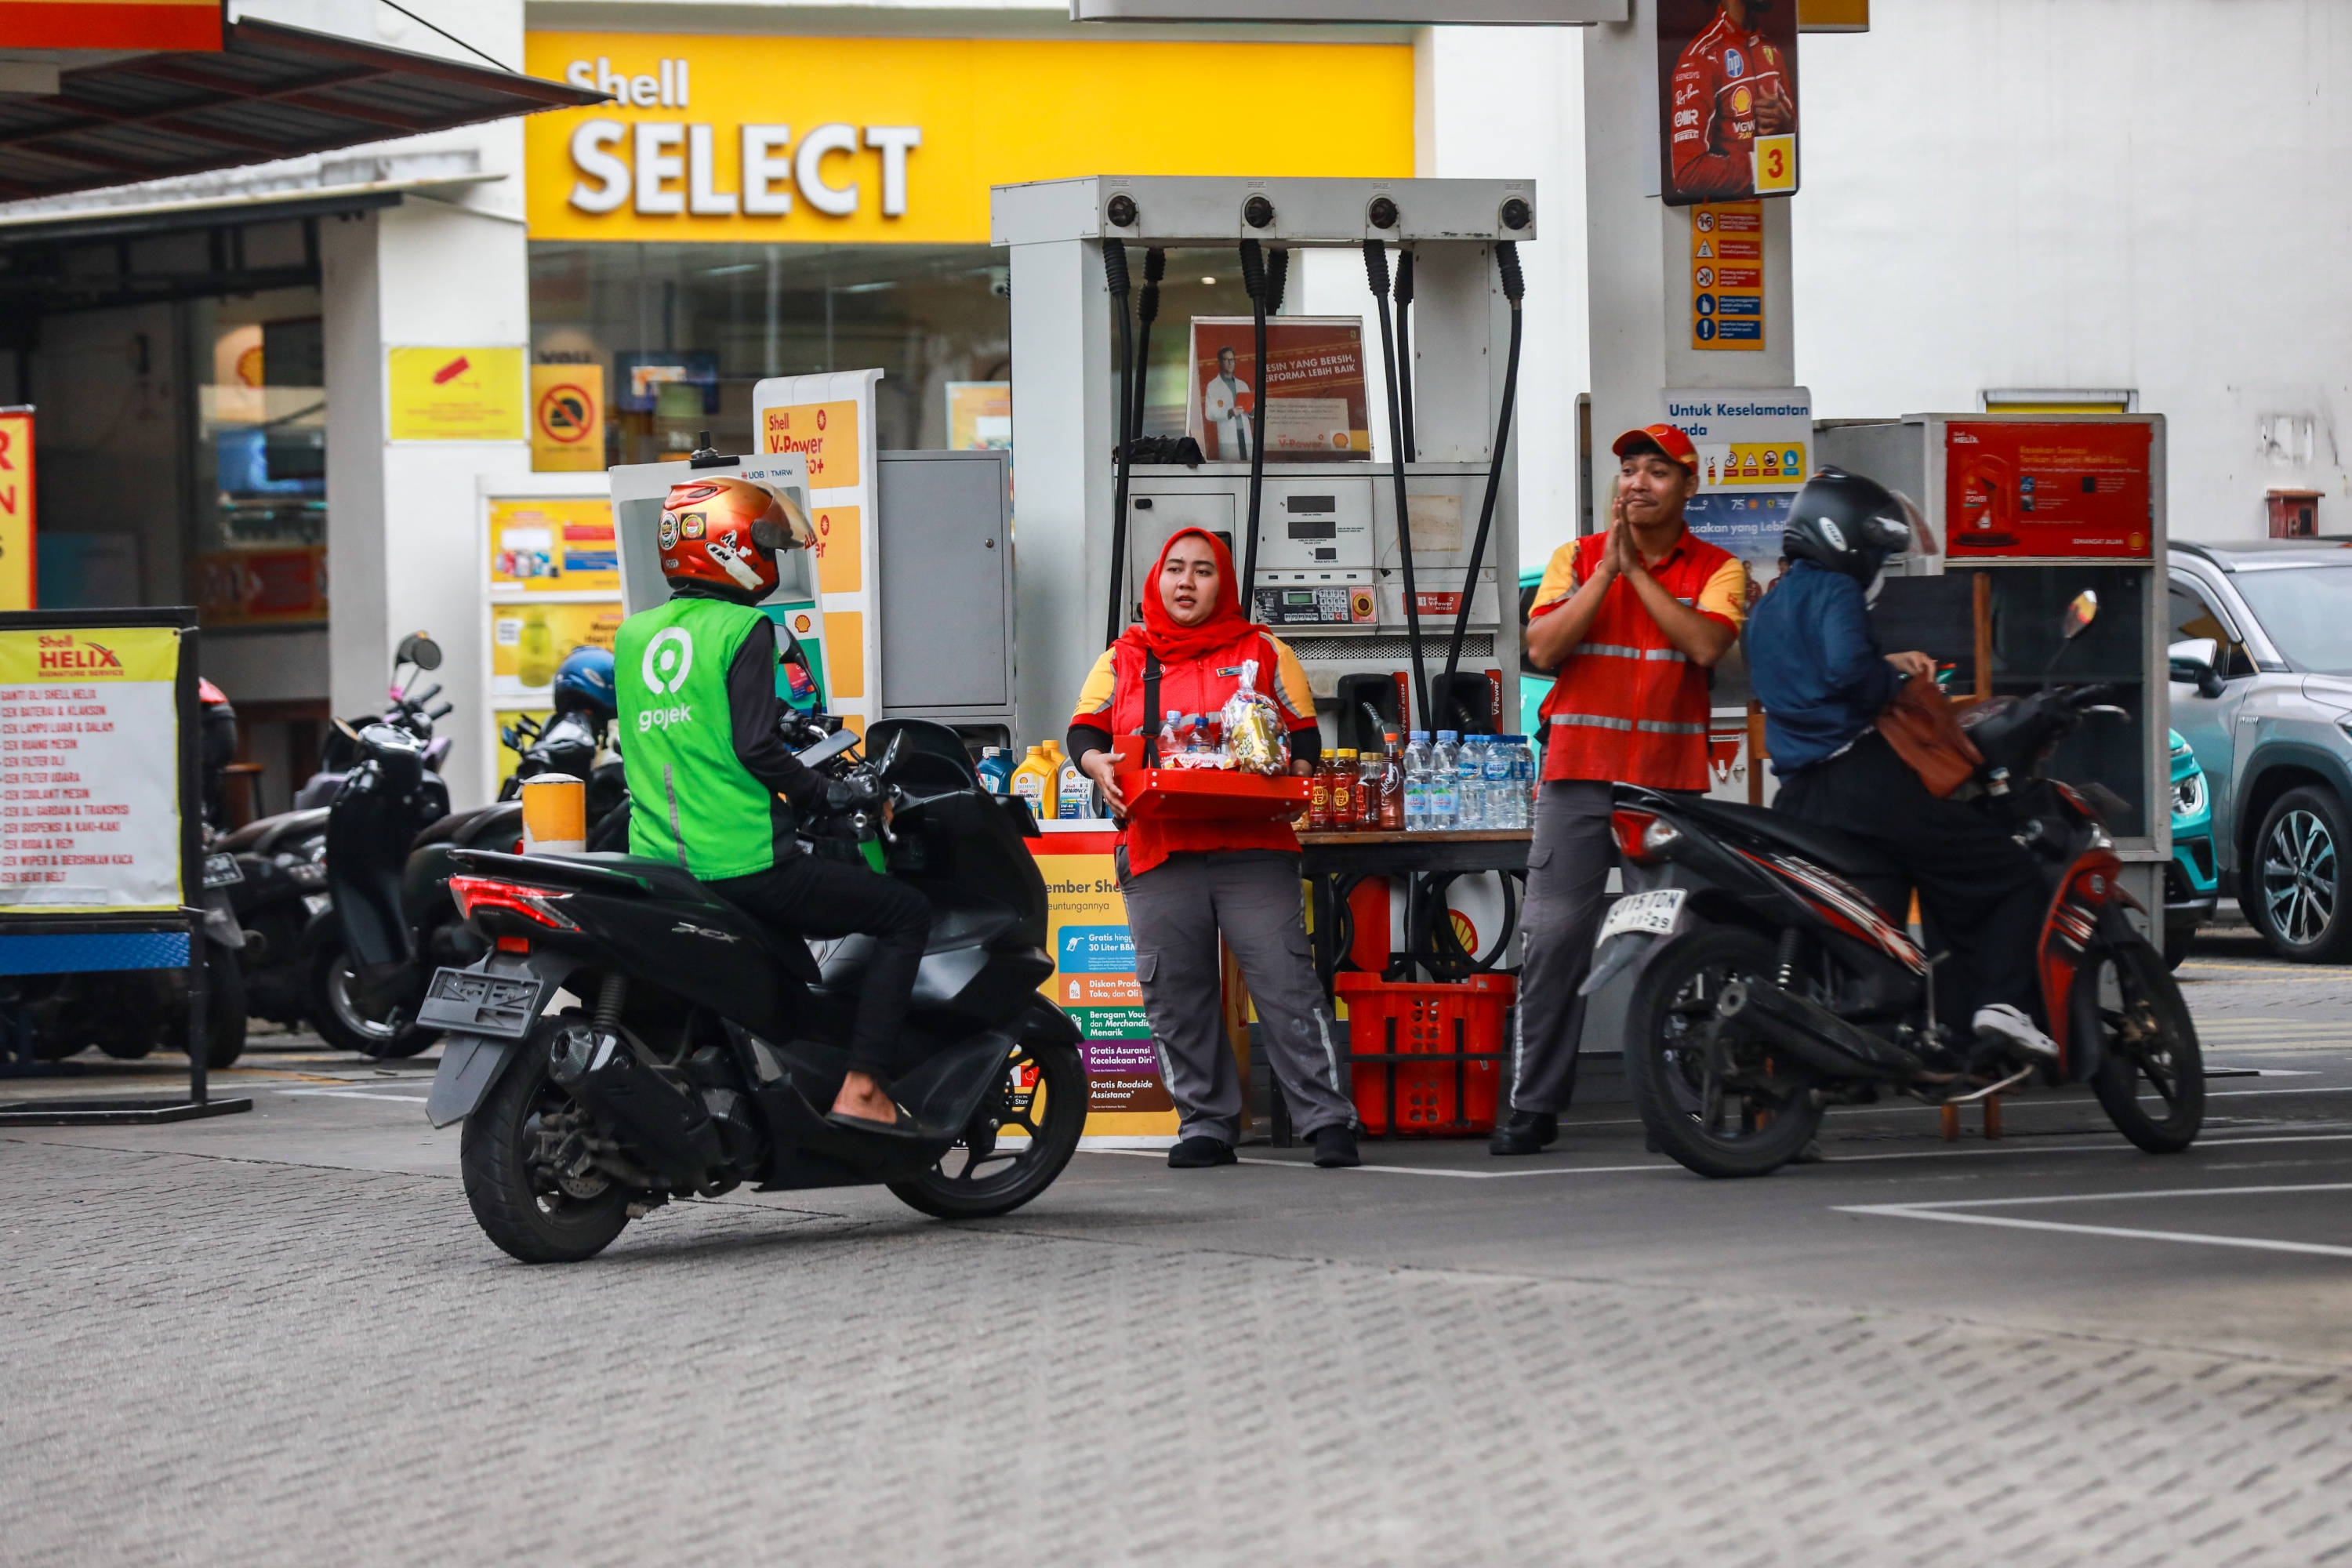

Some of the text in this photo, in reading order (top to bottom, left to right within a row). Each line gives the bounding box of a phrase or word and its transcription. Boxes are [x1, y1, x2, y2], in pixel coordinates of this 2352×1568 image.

[565, 56, 689, 107] Shell
[1733, 119, 1755, 132] VGW
[568, 119, 923, 216] SELECT
[1767, 149, 1784, 179] 3
[1266, 354, 1356, 372] ESIN YANG BERSIH,
[1265, 364, 1356, 383] ERFORMA LEBIH BAIK
[1670, 403, 1809, 416] Untuk Keselamatan
[769, 412, 789, 431] Shell
[770, 434, 823, 455] V-Power
[1279, 439, 1323, 448] V-Power
[1689, 522, 1728, 534] asakan
[1731, 524, 1758, 535] yang
[38, 634, 73, 648] Shell
[40, 649, 121, 669] HELIX
[45, 689, 71, 699] SHELL
[73, 689, 96, 699] HELIX
[67, 705, 107, 716] KLAKSON
[639, 702, 691, 732] gojek
[21, 723, 47, 733] LAMPU
[85, 722, 114, 732] DALAM
[51, 739, 77, 749] MESIN
[22, 756, 48, 766] FILTER
[23, 773, 48, 782] FILTER
[23, 789, 59, 800] COOLANT
[63, 789, 90, 799] MESIN
[56, 838, 74, 848] REM
[21, 855, 48, 866] WIPER
[20, 872, 42, 882] SEAT
[45, 871, 66, 882] BELT
[1046, 879, 1120, 893] ember She
[1047, 901, 1109, 913] euntungannya
[1088, 933, 1112, 942] Gratis
[1090, 1011, 1126, 1019] Beragam
[1090, 1028, 1123, 1036] Menarik
[1116, 1046, 1150, 1054] Asuransi
